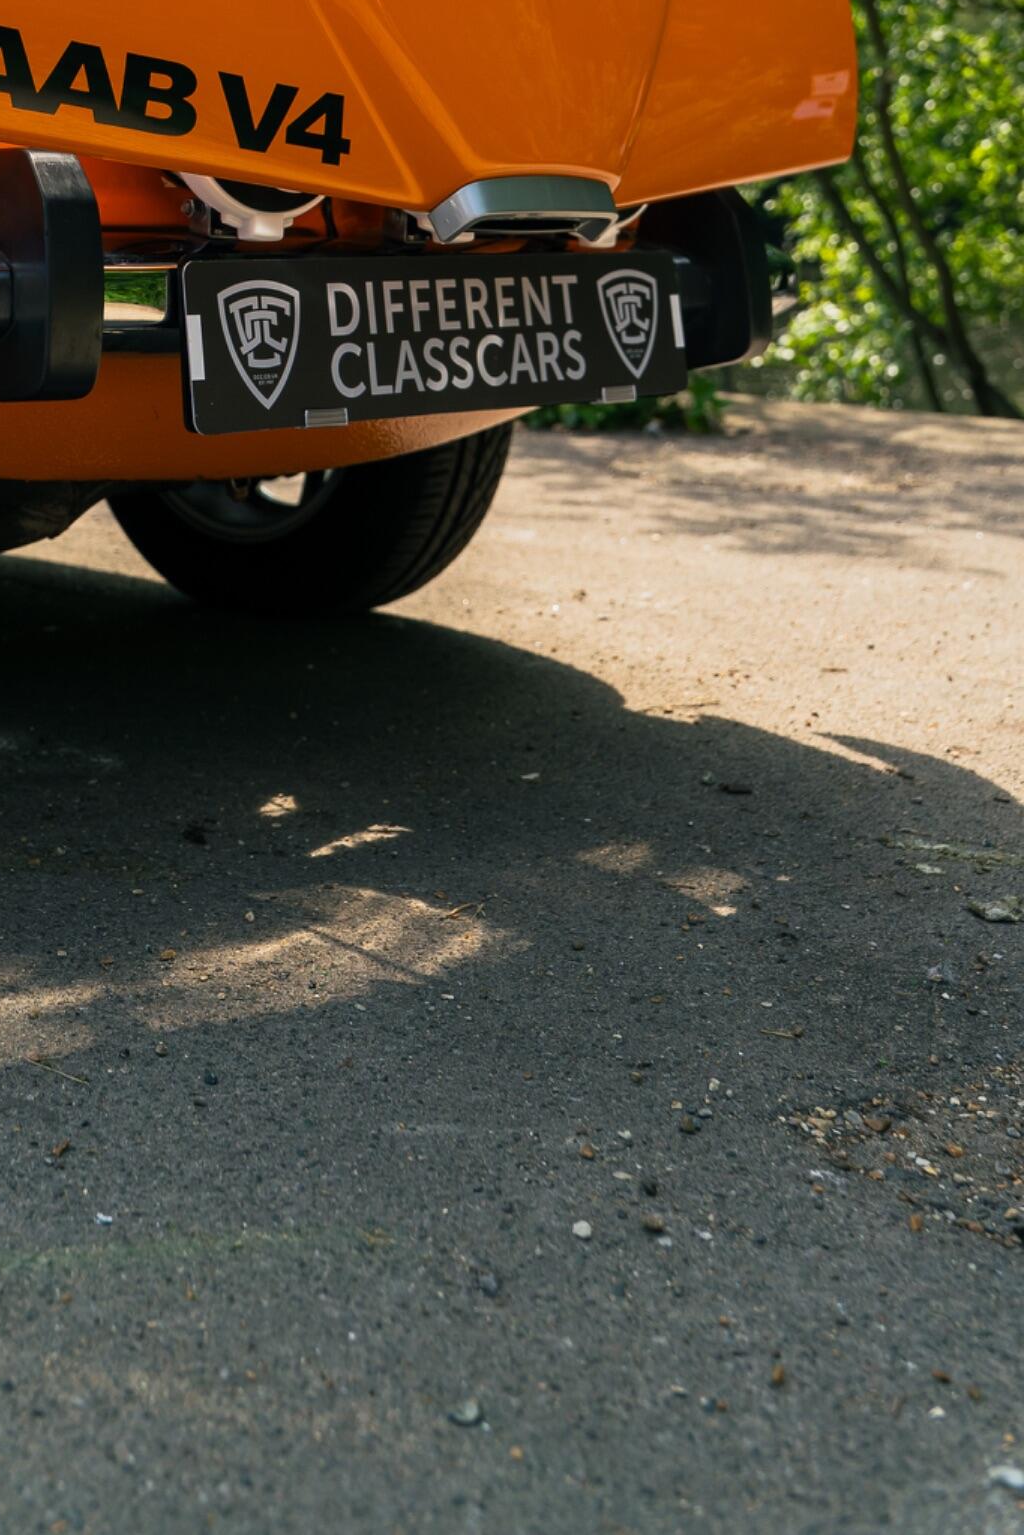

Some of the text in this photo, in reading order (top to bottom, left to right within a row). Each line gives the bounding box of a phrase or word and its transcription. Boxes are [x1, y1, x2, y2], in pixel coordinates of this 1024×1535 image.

[218, 71, 351, 166] V4
[326, 275, 578, 337] DIFFERENT
[330, 330, 587, 399] CLASSCARS
